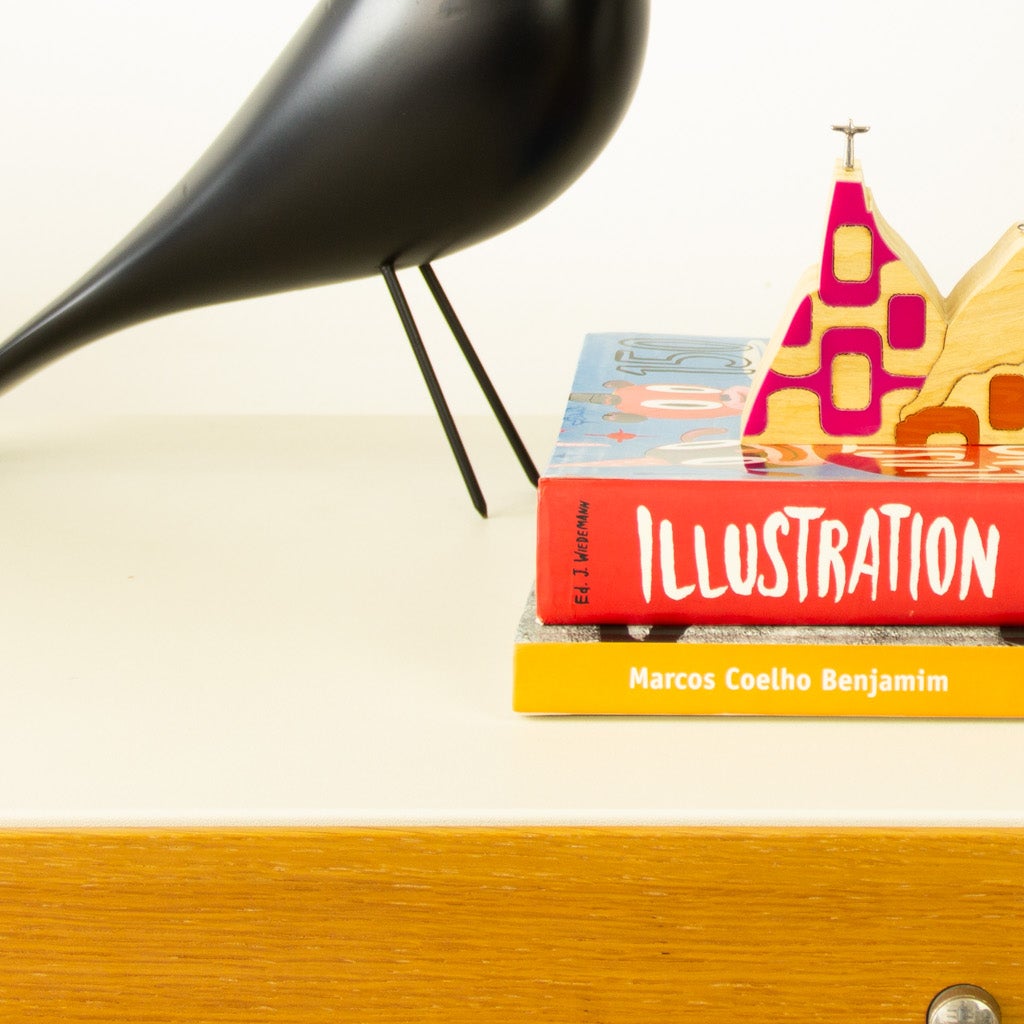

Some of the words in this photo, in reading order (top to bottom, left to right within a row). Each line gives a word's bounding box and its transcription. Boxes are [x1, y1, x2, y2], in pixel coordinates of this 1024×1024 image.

[615, 337, 757, 376] 150
[573, 500, 590, 563] WIEDEMANN
[636, 503, 1001, 604] ILLUSTRATION
[572, 567, 590, 577] J.
[573, 582, 590, 606] Ed.
[629, 666, 716, 691] Marcos
[724, 666, 812, 692] Coelho
[821, 667, 949, 698] Benjamim
